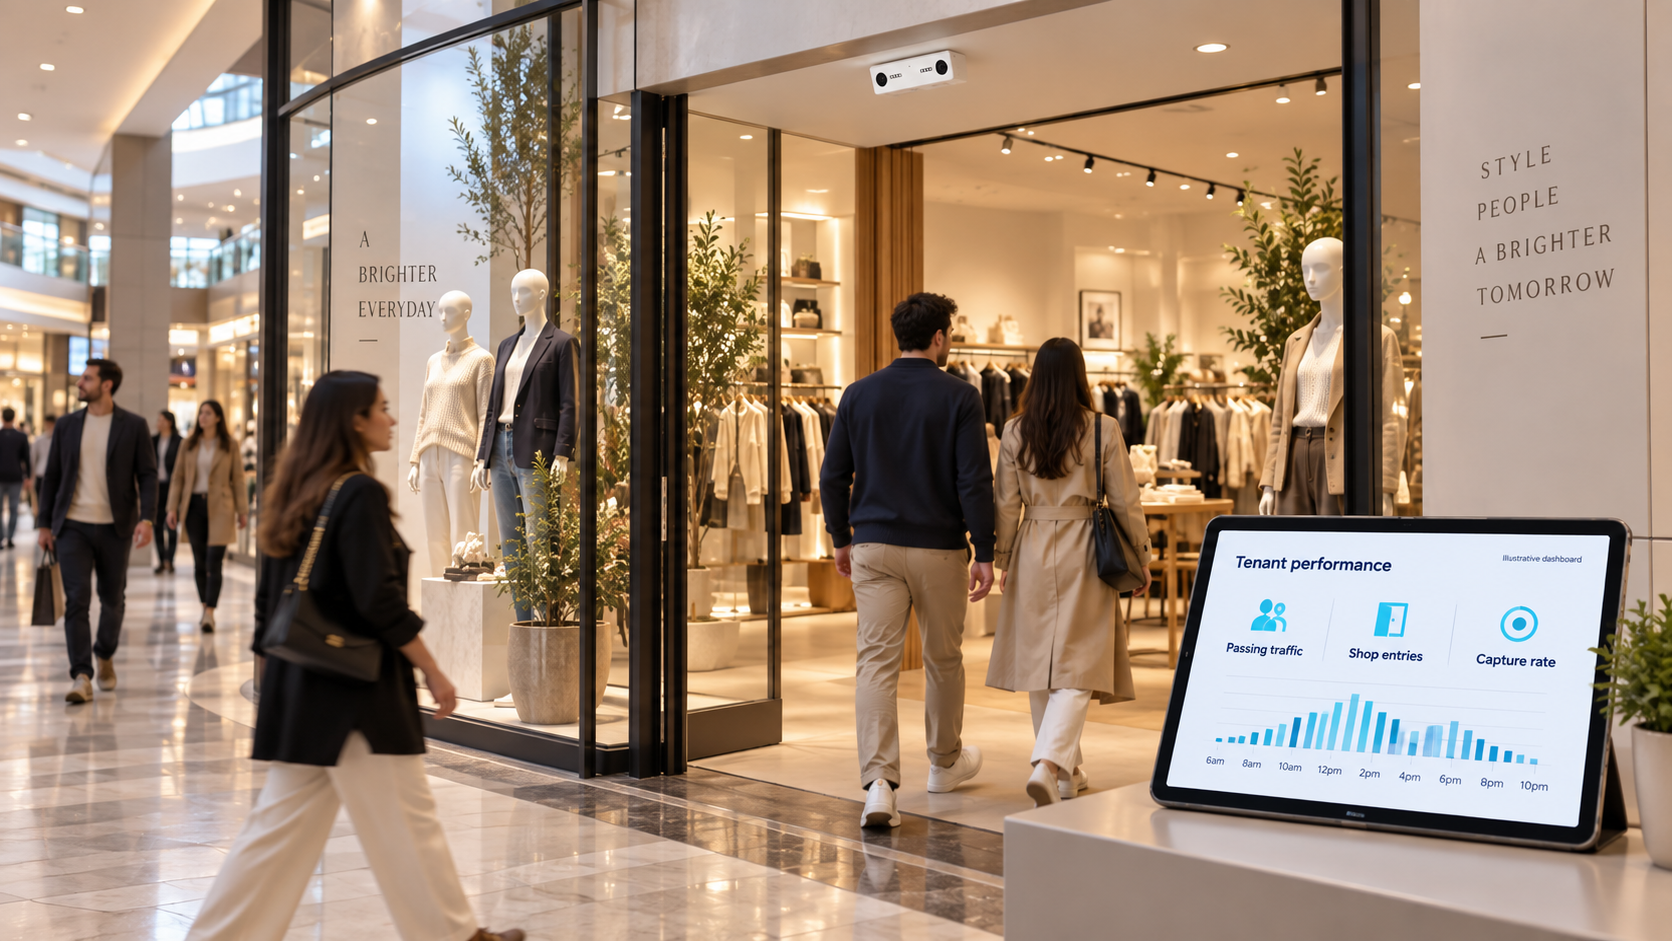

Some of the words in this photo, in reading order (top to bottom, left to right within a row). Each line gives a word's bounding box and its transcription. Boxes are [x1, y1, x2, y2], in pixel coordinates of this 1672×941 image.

[1481, 144, 1552, 180] STYLE
[1477, 185, 1559, 221] PEOPLE
[359, 230, 370, 248] A
[1474, 246, 1487, 266] A
[1496, 223, 1612, 262] BRIGHTER
[358, 264, 438, 283] BRIGHTER
[1476, 267, 1615, 306] TOMORROW
[358, 300, 436, 318] EVERYDAY
[1235, 555, 1288, 570] Tenant
[1289, 556, 1393, 573] performance
[1502, 554, 1541, 563] Illustrative
[1541, 555, 1583, 564] dashboard
[1226, 642, 1268, 657] Passing
[1269, 644, 1304, 657] traffic
[1348, 647, 1380, 662] Shop
[1381, 649, 1424, 662] entries
[1475, 653, 1528, 668] Capture
[1529, 656, 1557, 668] rate
[1205, 755, 1226, 766] 6am
[1241, 758, 1262, 769] 8am
[1278, 761, 1303, 773] 10am
[1317, 765, 1343, 777] 12pm
[1358, 768, 1381, 780] 2pm
[1398, 771, 1422, 783] 4pm
[1438, 774, 1462, 787] 6pm
[1480, 777, 1504, 790] 8pm
[1520, 780, 1549, 793] 10pm
